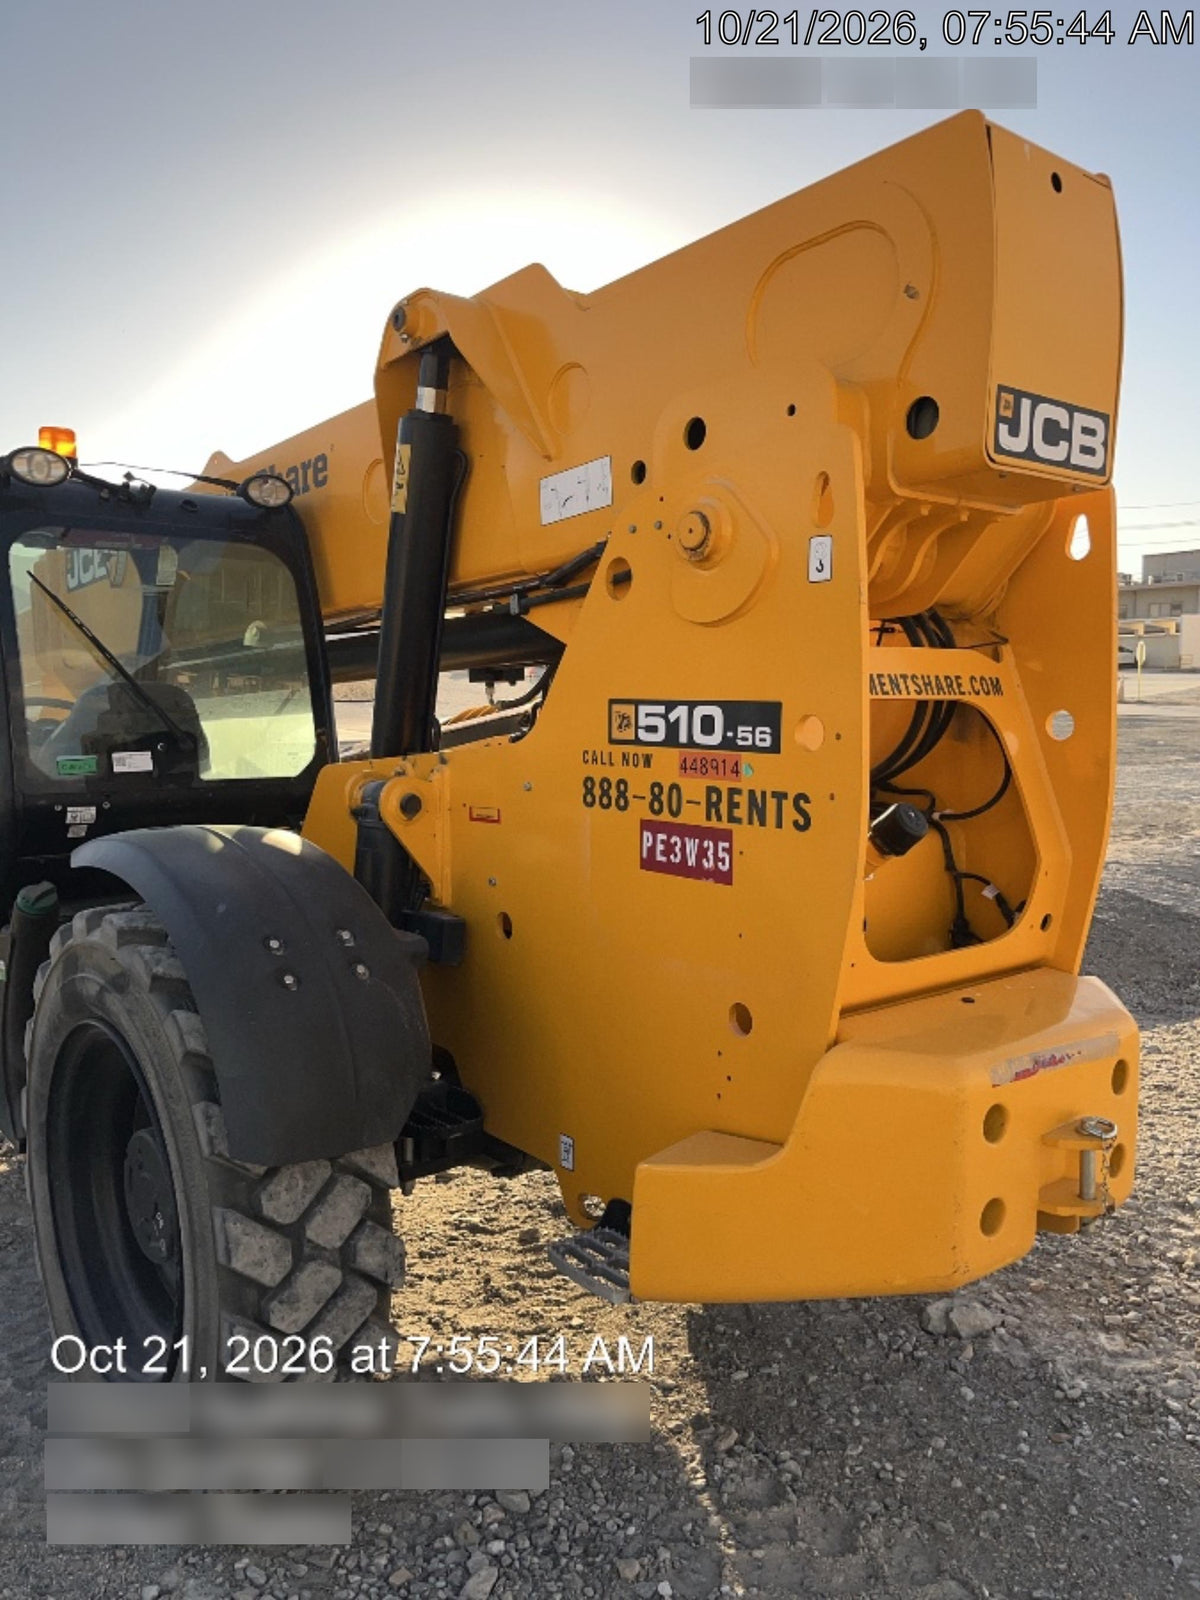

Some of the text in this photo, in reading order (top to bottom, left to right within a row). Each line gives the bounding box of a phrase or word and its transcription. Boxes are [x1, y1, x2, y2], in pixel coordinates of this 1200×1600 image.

[998, 397, 1105, 470] JCB
[582, 750, 653, 769] CALL NOW
[680, 756, 741, 778] 448914
[582, 776, 812, 832] 888-80-RENTS
[642, 830, 730, 872] PE3W35
